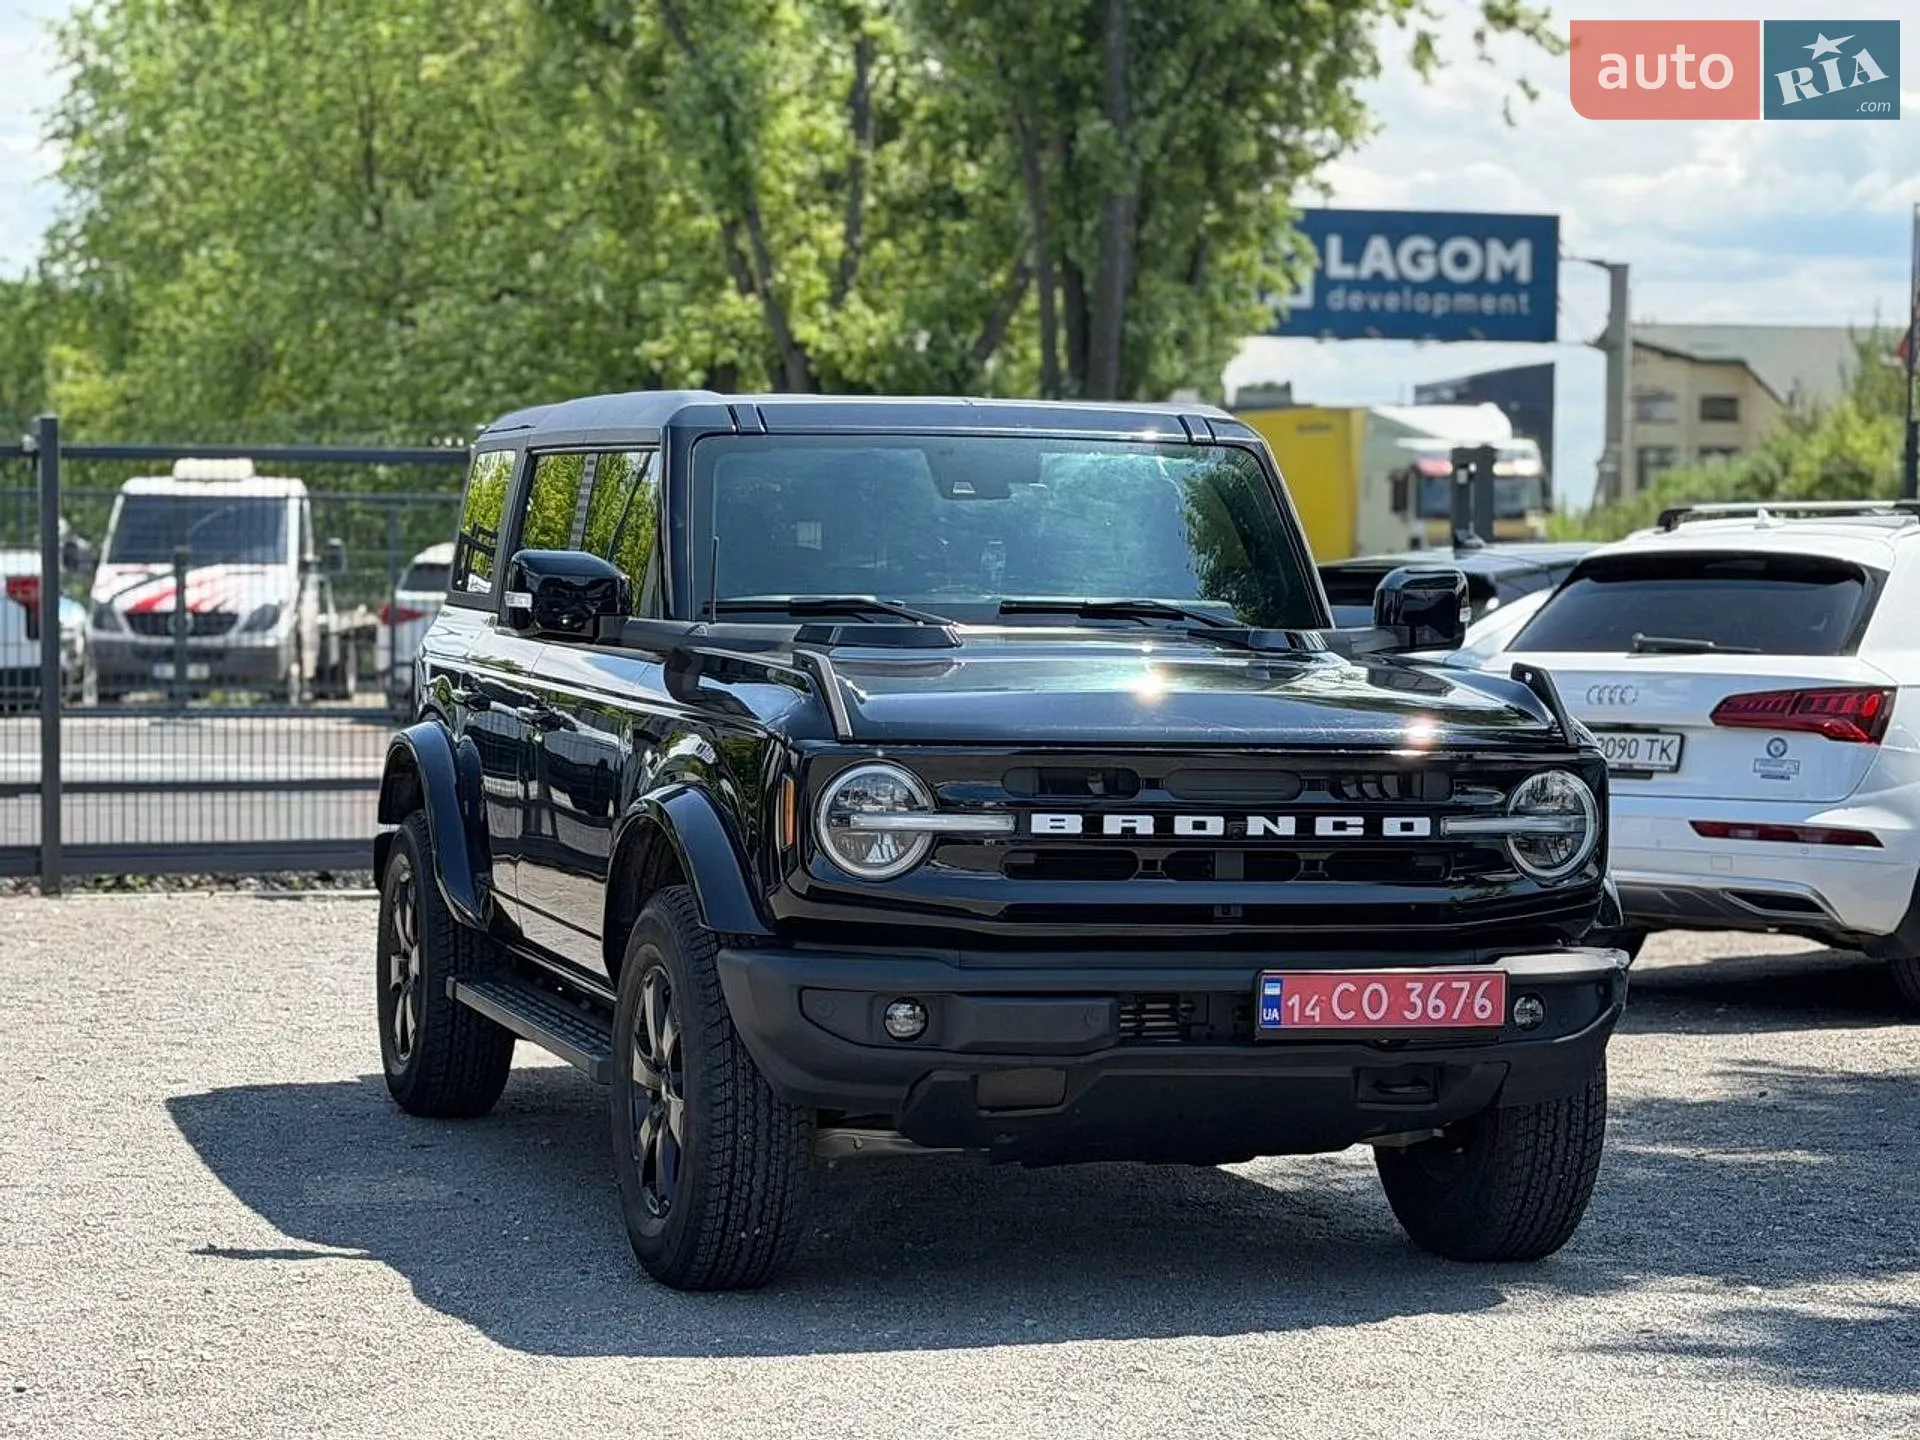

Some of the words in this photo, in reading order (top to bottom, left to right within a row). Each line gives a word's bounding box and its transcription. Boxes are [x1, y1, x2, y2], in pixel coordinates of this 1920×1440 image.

[1325, 233, 1533, 284] LAGOM
[1326, 286, 1530, 317] development
[1646, 738, 1676, 761] TK
[1030, 814, 1431, 836] BRONCO
[1263, 1007, 1280, 1021] UA
[1287, 994, 1320, 1023] 14
[1331, 982, 1389, 1020] CO
[1403, 981, 1493, 1020] 3676
